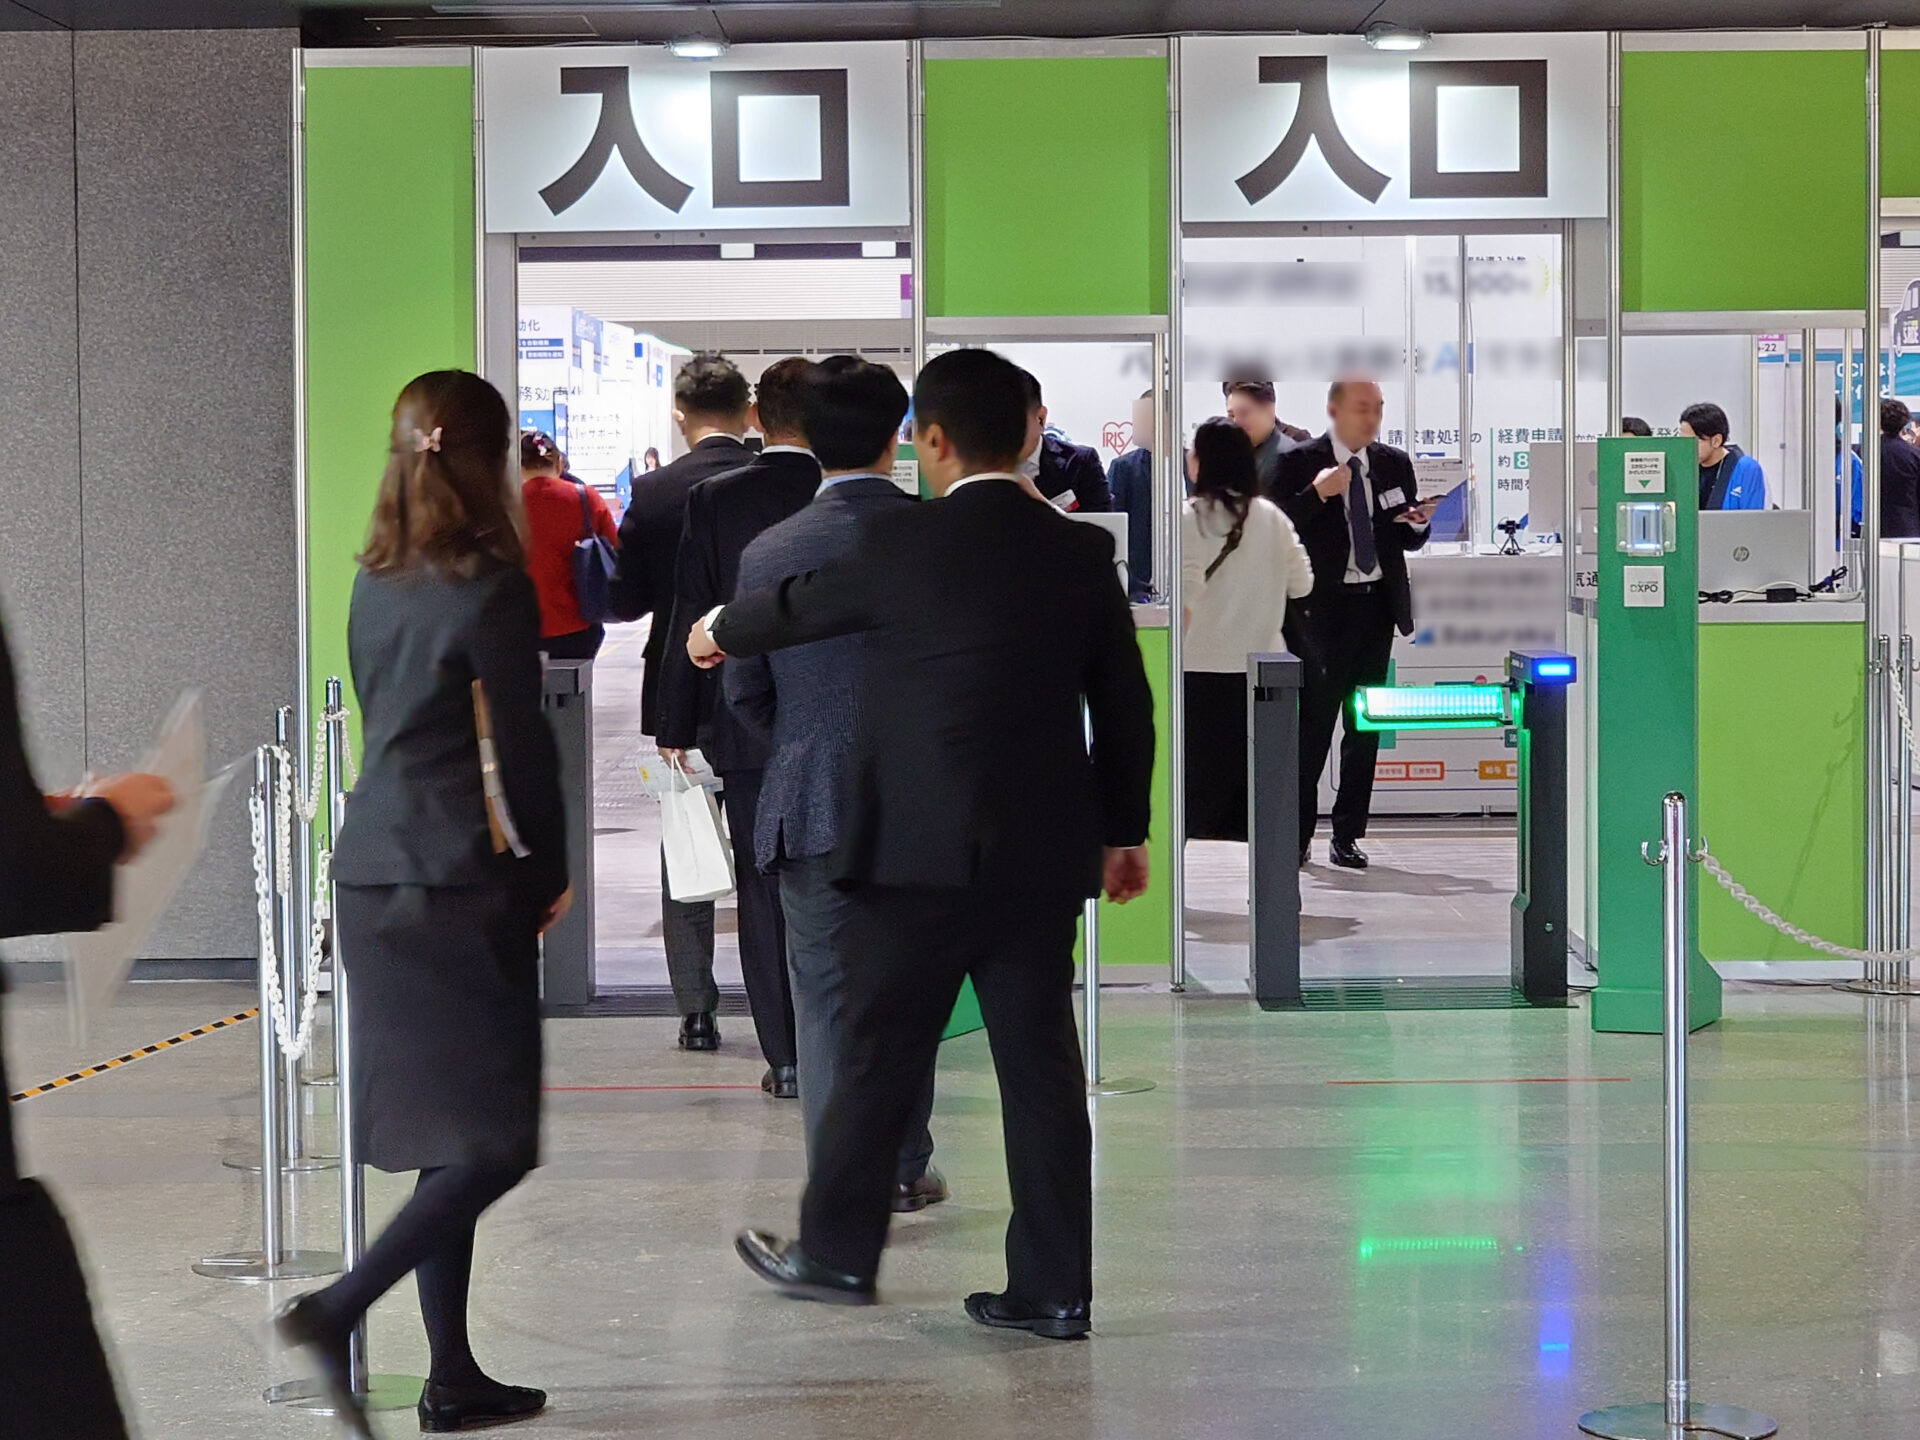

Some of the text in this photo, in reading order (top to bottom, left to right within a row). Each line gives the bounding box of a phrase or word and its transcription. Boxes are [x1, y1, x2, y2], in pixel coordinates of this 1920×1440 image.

[538, 65, 850, 217] 入口
[1234, 55, 1549, 206] 入口
[1102, 431, 1126, 449] IRIS
[1630, 583, 1659, 593] DXPO
